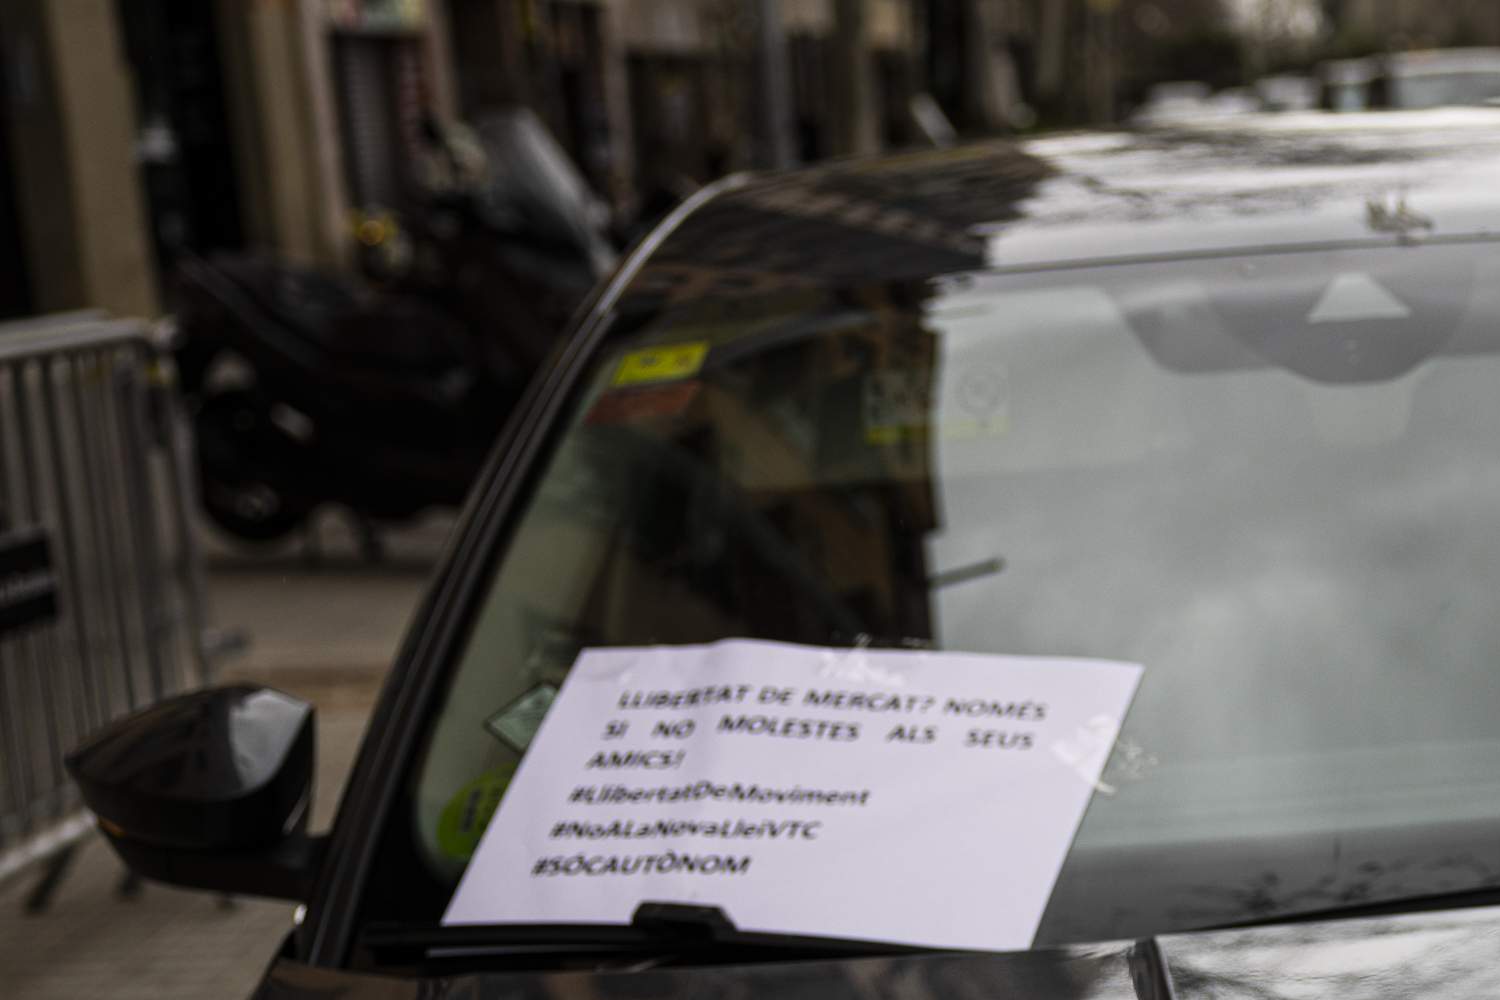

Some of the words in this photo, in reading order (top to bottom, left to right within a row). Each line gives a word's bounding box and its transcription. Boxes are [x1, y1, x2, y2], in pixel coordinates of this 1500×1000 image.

[616, 684, 752, 710] LLIBERTAT
[757, 685, 797, 706] DE
[801, 688, 937, 714] MERCAT?
[602, 719, 631, 741] SI
[650, 718, 696, 741] NO
[714, 713, 862, 742] MOLESTES
[885, 724, 937, 745] ALS
[964, 727, 1036, 750] SEUS
[584, 749, 687, 771] AMICS!
